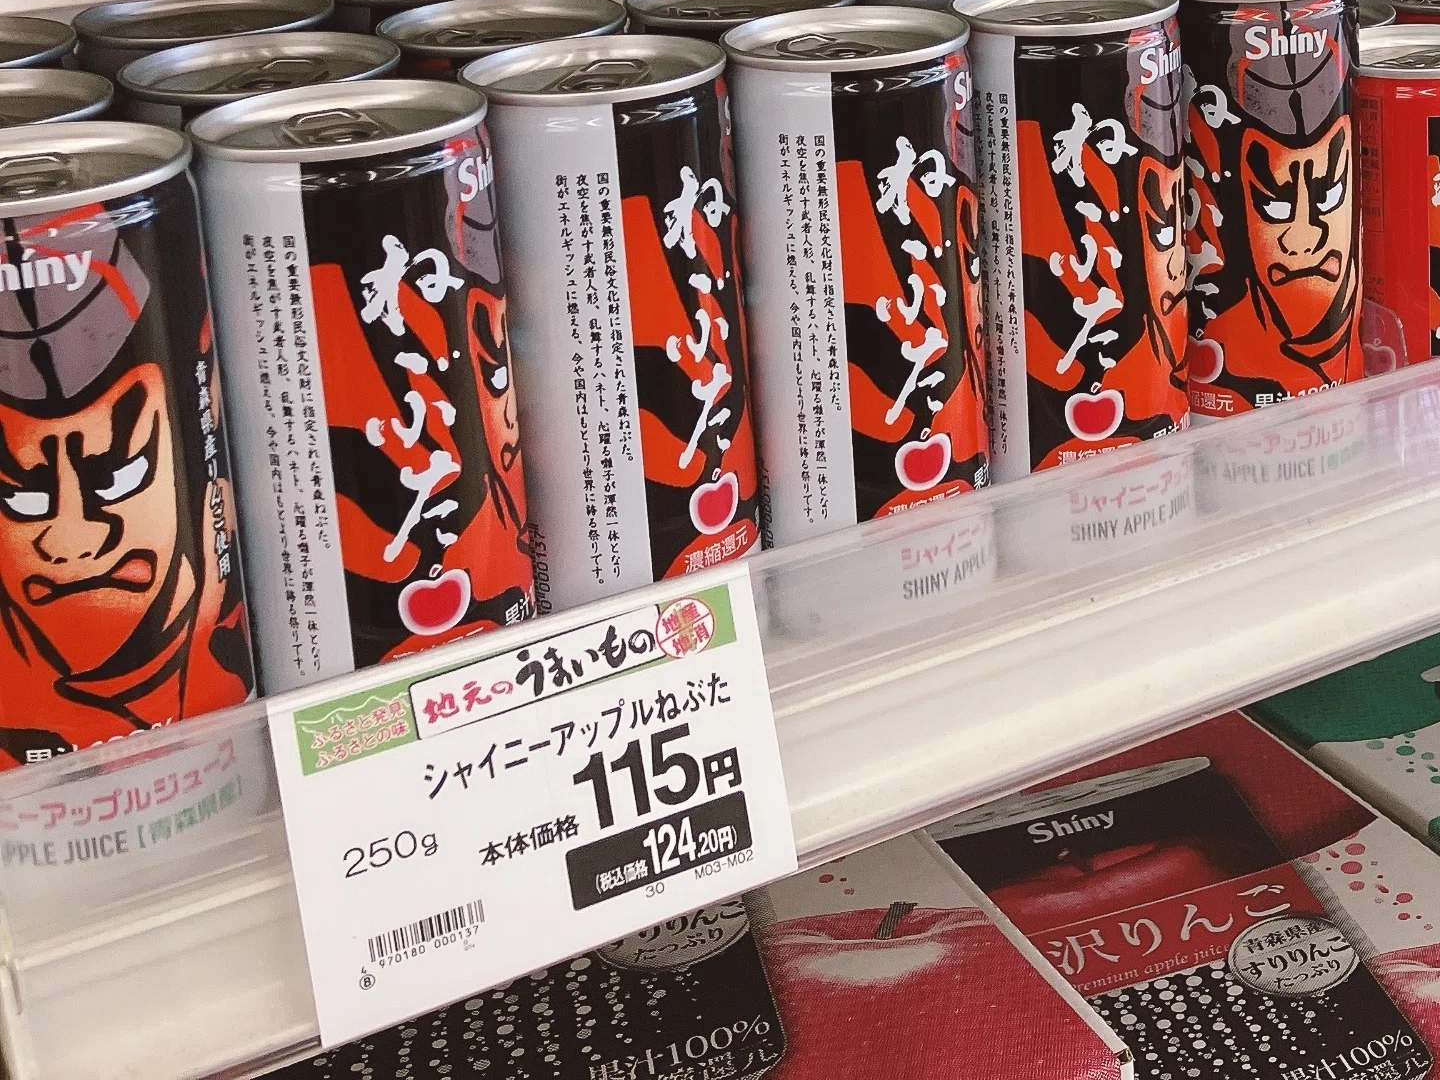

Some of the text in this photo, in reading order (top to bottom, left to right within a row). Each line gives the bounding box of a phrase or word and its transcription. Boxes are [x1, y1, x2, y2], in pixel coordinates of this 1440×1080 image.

[1244, 26, 1329, 62] Shiny
[1049, 102, 1139, 375] ねぶた
[876, 136, 956, 425] ねぶた
[664, 166, 731, 471] ねぶた
[362, 234, 465, 562] ねぶた
[684, 527, 750, 574] 濃縮還元
[422, 625, 656, 725] 地元のうまいもの
[311, 698, 407, 751] ふるさと発見
[315, 720, 409, 769] ふるさとの味
[422, 672, 732, 800] シャイニーアップルねぶた
[478, 723, 742, 867] 本体価格 115円
[63, 830, 129, 865] JUICE
[1026, 810, 1116, 845] Shiny
[342, 829, 439, 879] 250g
[644, 848, 754, 899] 30 M03-M02
[634, 927, 724, 963] たっぷり
[1241, 934, 1351, 980] すりりんご
[1273, 960, 1341, 990] たっぷり
